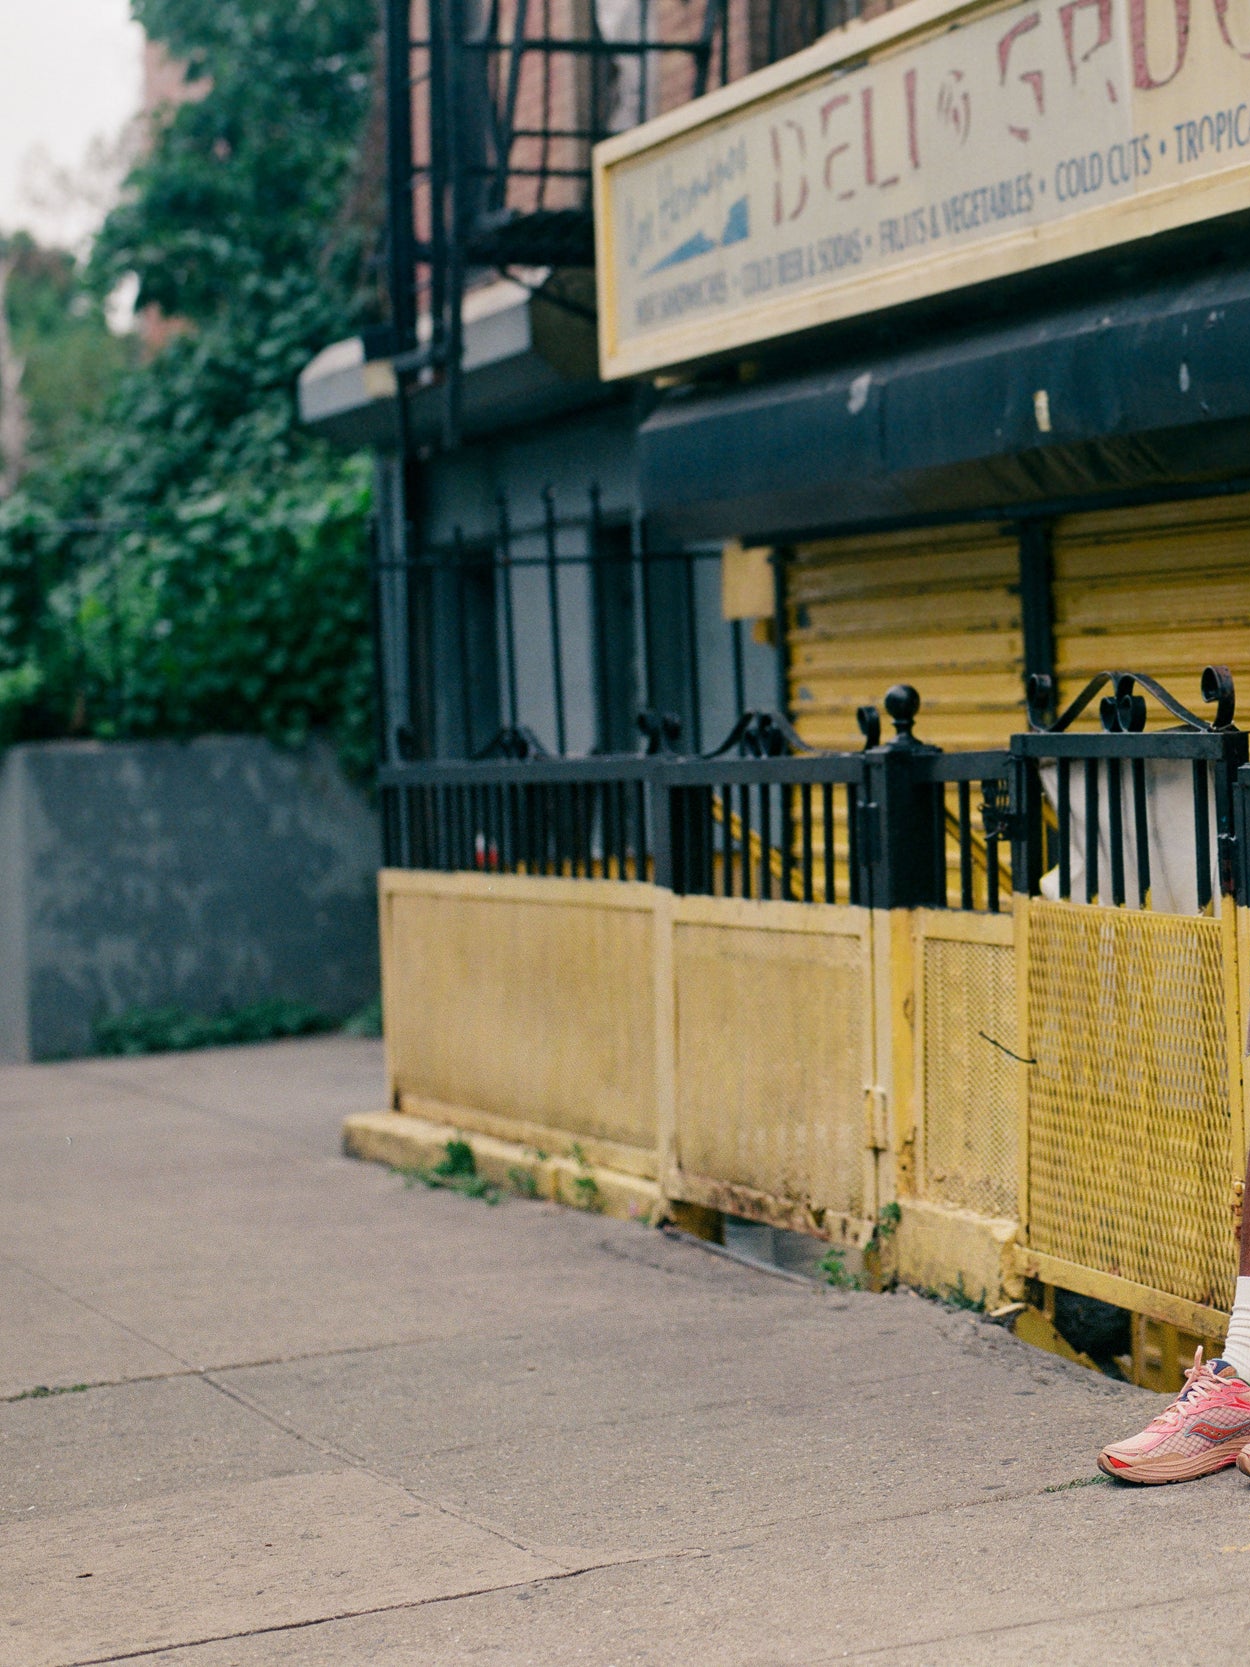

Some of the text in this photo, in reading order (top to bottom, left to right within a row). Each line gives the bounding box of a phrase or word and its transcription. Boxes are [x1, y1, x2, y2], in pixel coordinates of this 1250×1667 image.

[770, 67, 920, 226] DELI
[878, 205, 927, 253] FRUITS
[942, 171, 1036, 235] VEGETABLES
[1054, 151, 1105, 202] COLD
[1107, 133, 1153, 187] CUTS
